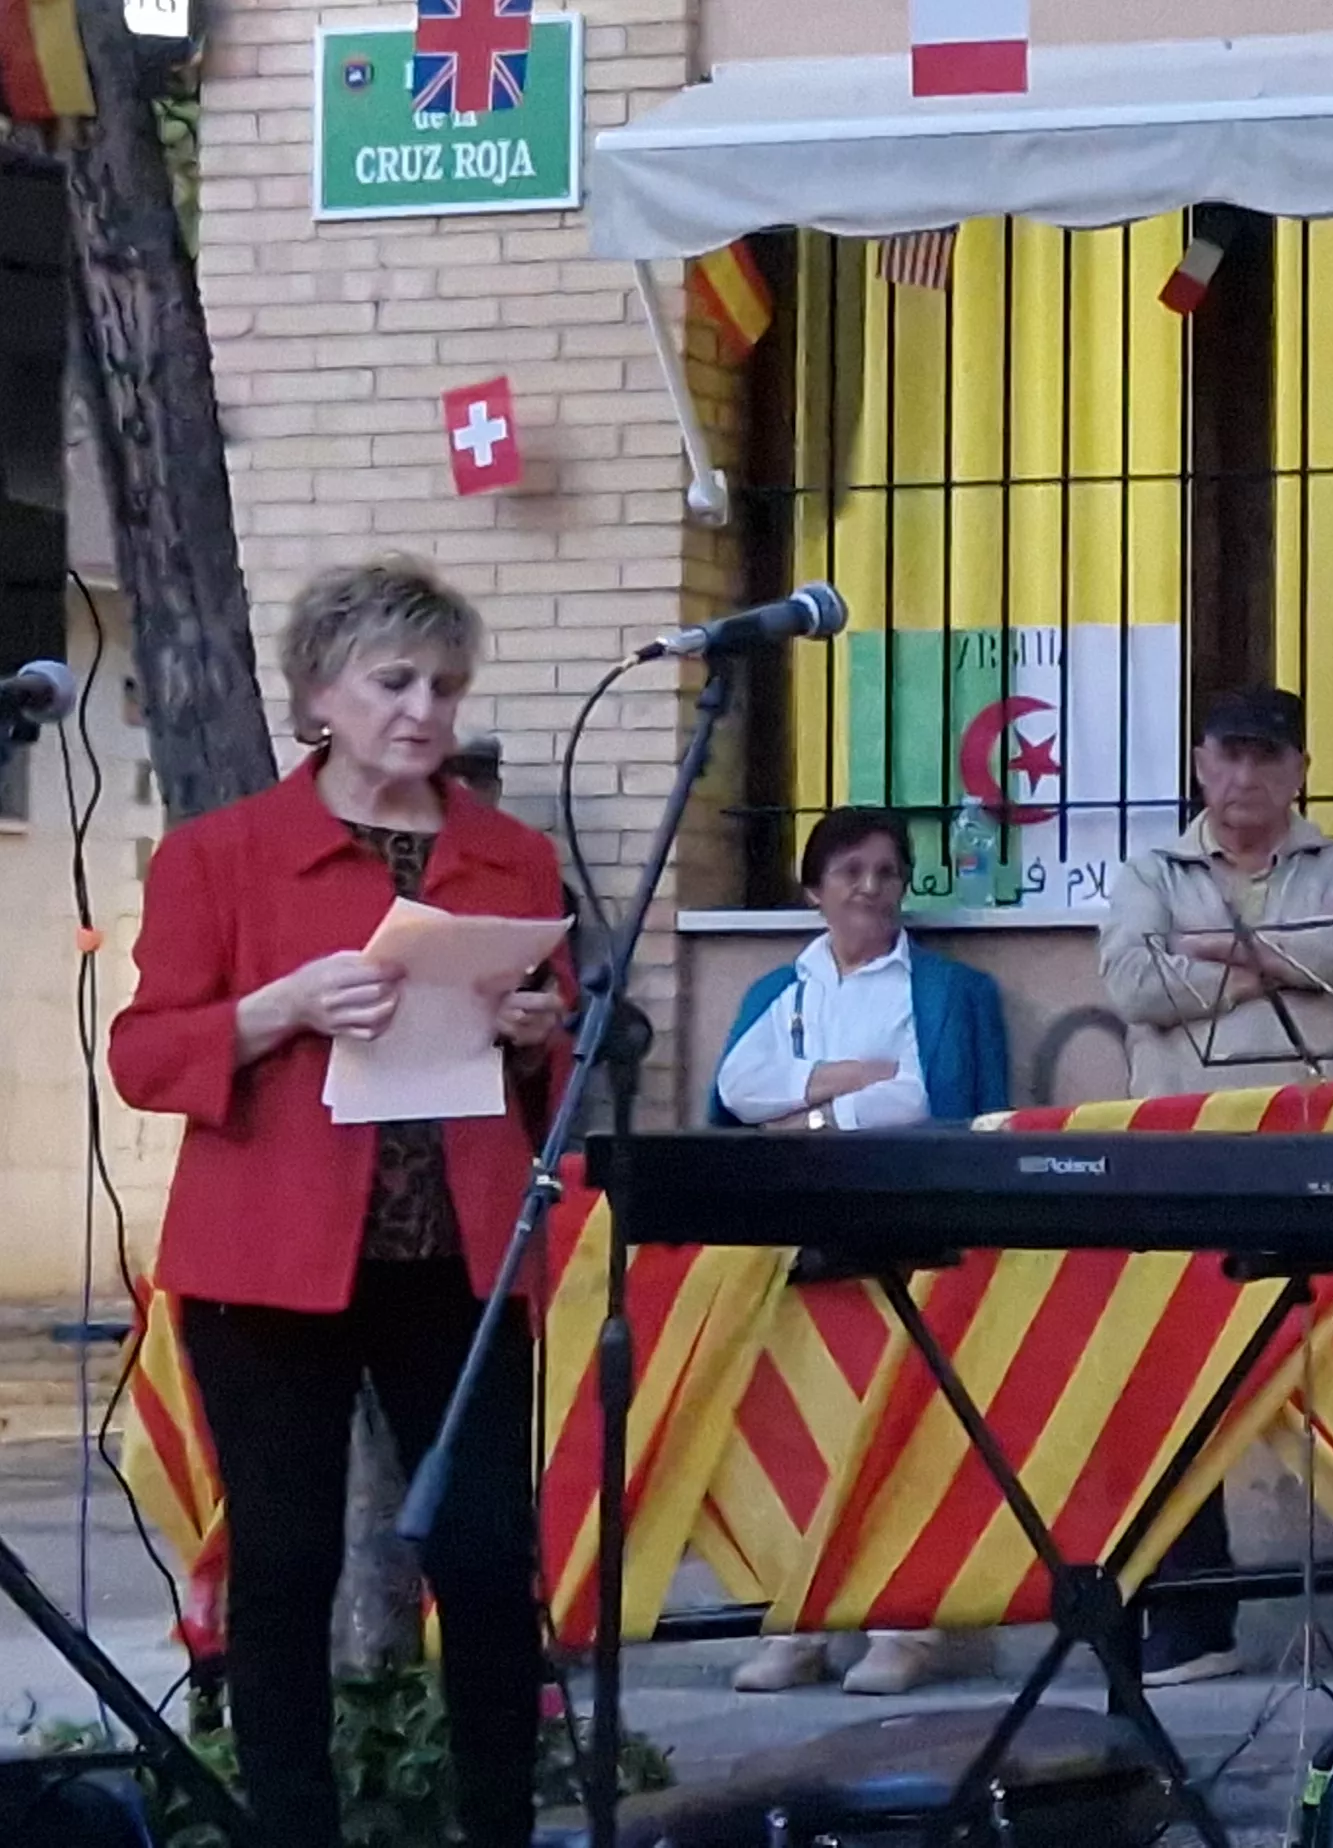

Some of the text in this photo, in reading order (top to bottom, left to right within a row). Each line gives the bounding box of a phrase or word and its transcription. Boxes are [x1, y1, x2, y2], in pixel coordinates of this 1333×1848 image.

[355, 138, 537, 187] CRUZ ROJA
[1047, 1155, 1106, 1175] Roland
